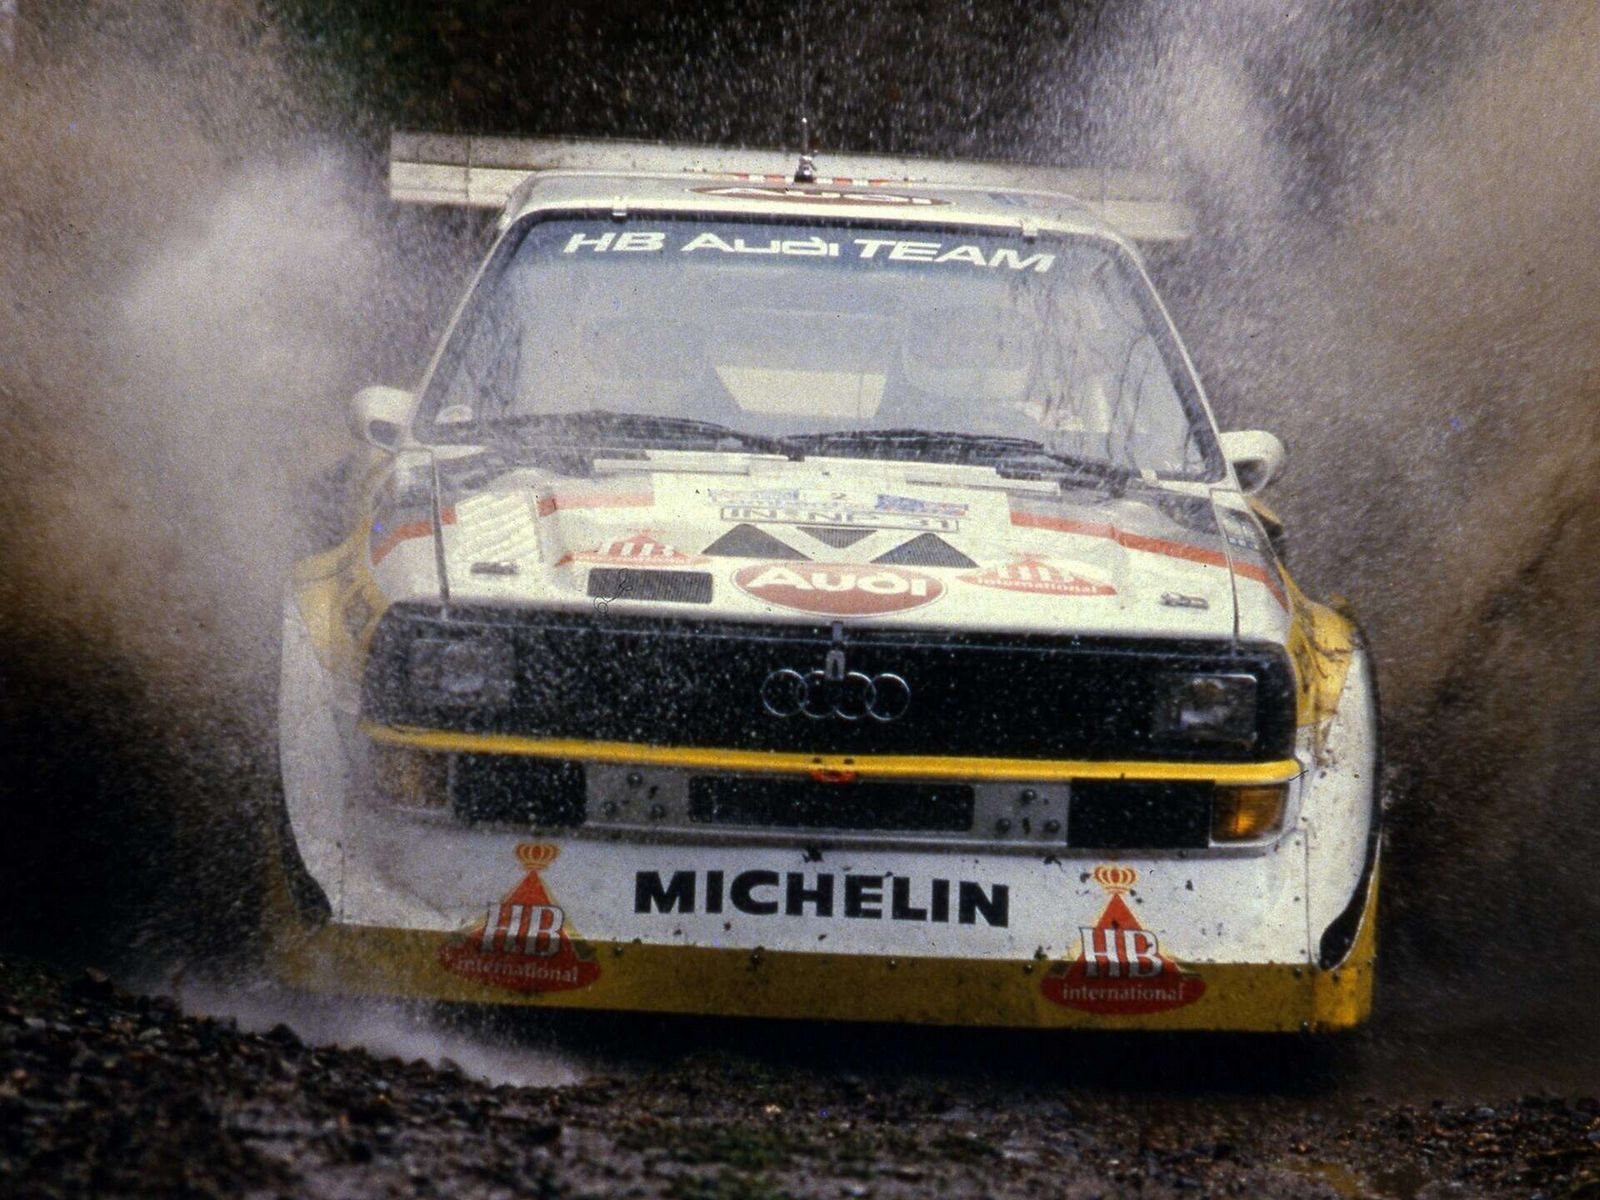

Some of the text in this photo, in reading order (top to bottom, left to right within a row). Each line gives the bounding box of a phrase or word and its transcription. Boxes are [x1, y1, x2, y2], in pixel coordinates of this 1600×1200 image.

[563, 232, 666, 253] HB
[854, 238, 1056, 273] TEAM
[634, 869, 1010, 928] MICHELIN
[480, 902, 565, 958] HB
[1079, 926, 1164, 977] HB
[453, 956, 578, 984] international
[1062, 982, 1184, 1001] international
